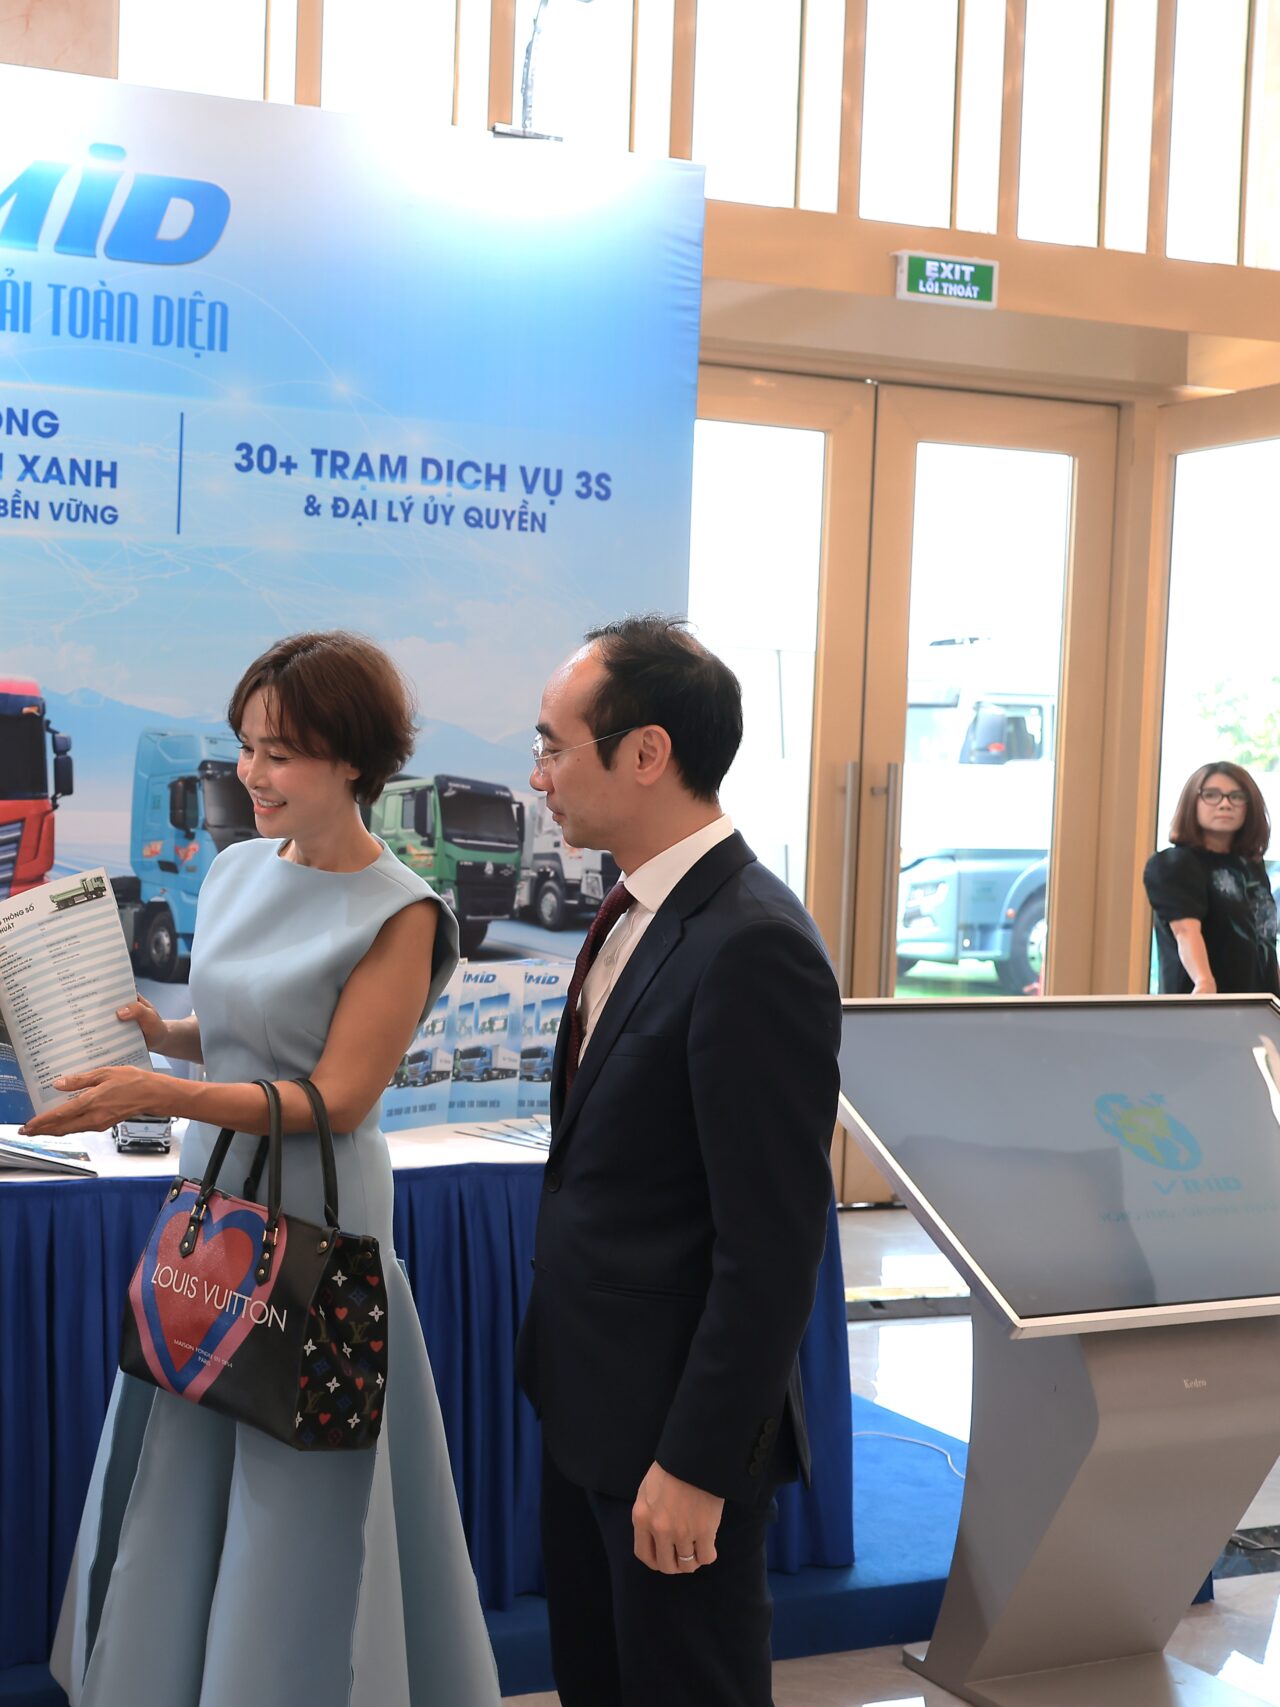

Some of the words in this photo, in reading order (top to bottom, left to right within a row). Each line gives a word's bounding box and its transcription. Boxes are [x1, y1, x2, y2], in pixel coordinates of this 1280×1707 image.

[925, 259, 975, 282] EXIT
[941, 283, 979, 299] THOÁT
[47, 280, 139, 344] TOÀN
[152, 290, 229, 358] DIỆN
[16, 453, 118, 489] XANH
[233, 441, 298, 477] 30+
[310, 447, 408, 492] TRẠM
[420, 456, 507, 497] DỊCH
[519, 464, 563, 506] VỤ
[574, 470, 613, 502] 3S
[48, 498, 119, 525] VỮNG
[303, 494, 321, 518] &
[331, 496, 377, 527] ĐẠI
[387, 494, 415, 524] LÝ
[422, 495, 455, 526] ỦY
[463, 498, 547, 534] QUYỀN
[150, 1263, 199, 1299] LOUIS
[204, 1280, 288, 1333] VUITTON
